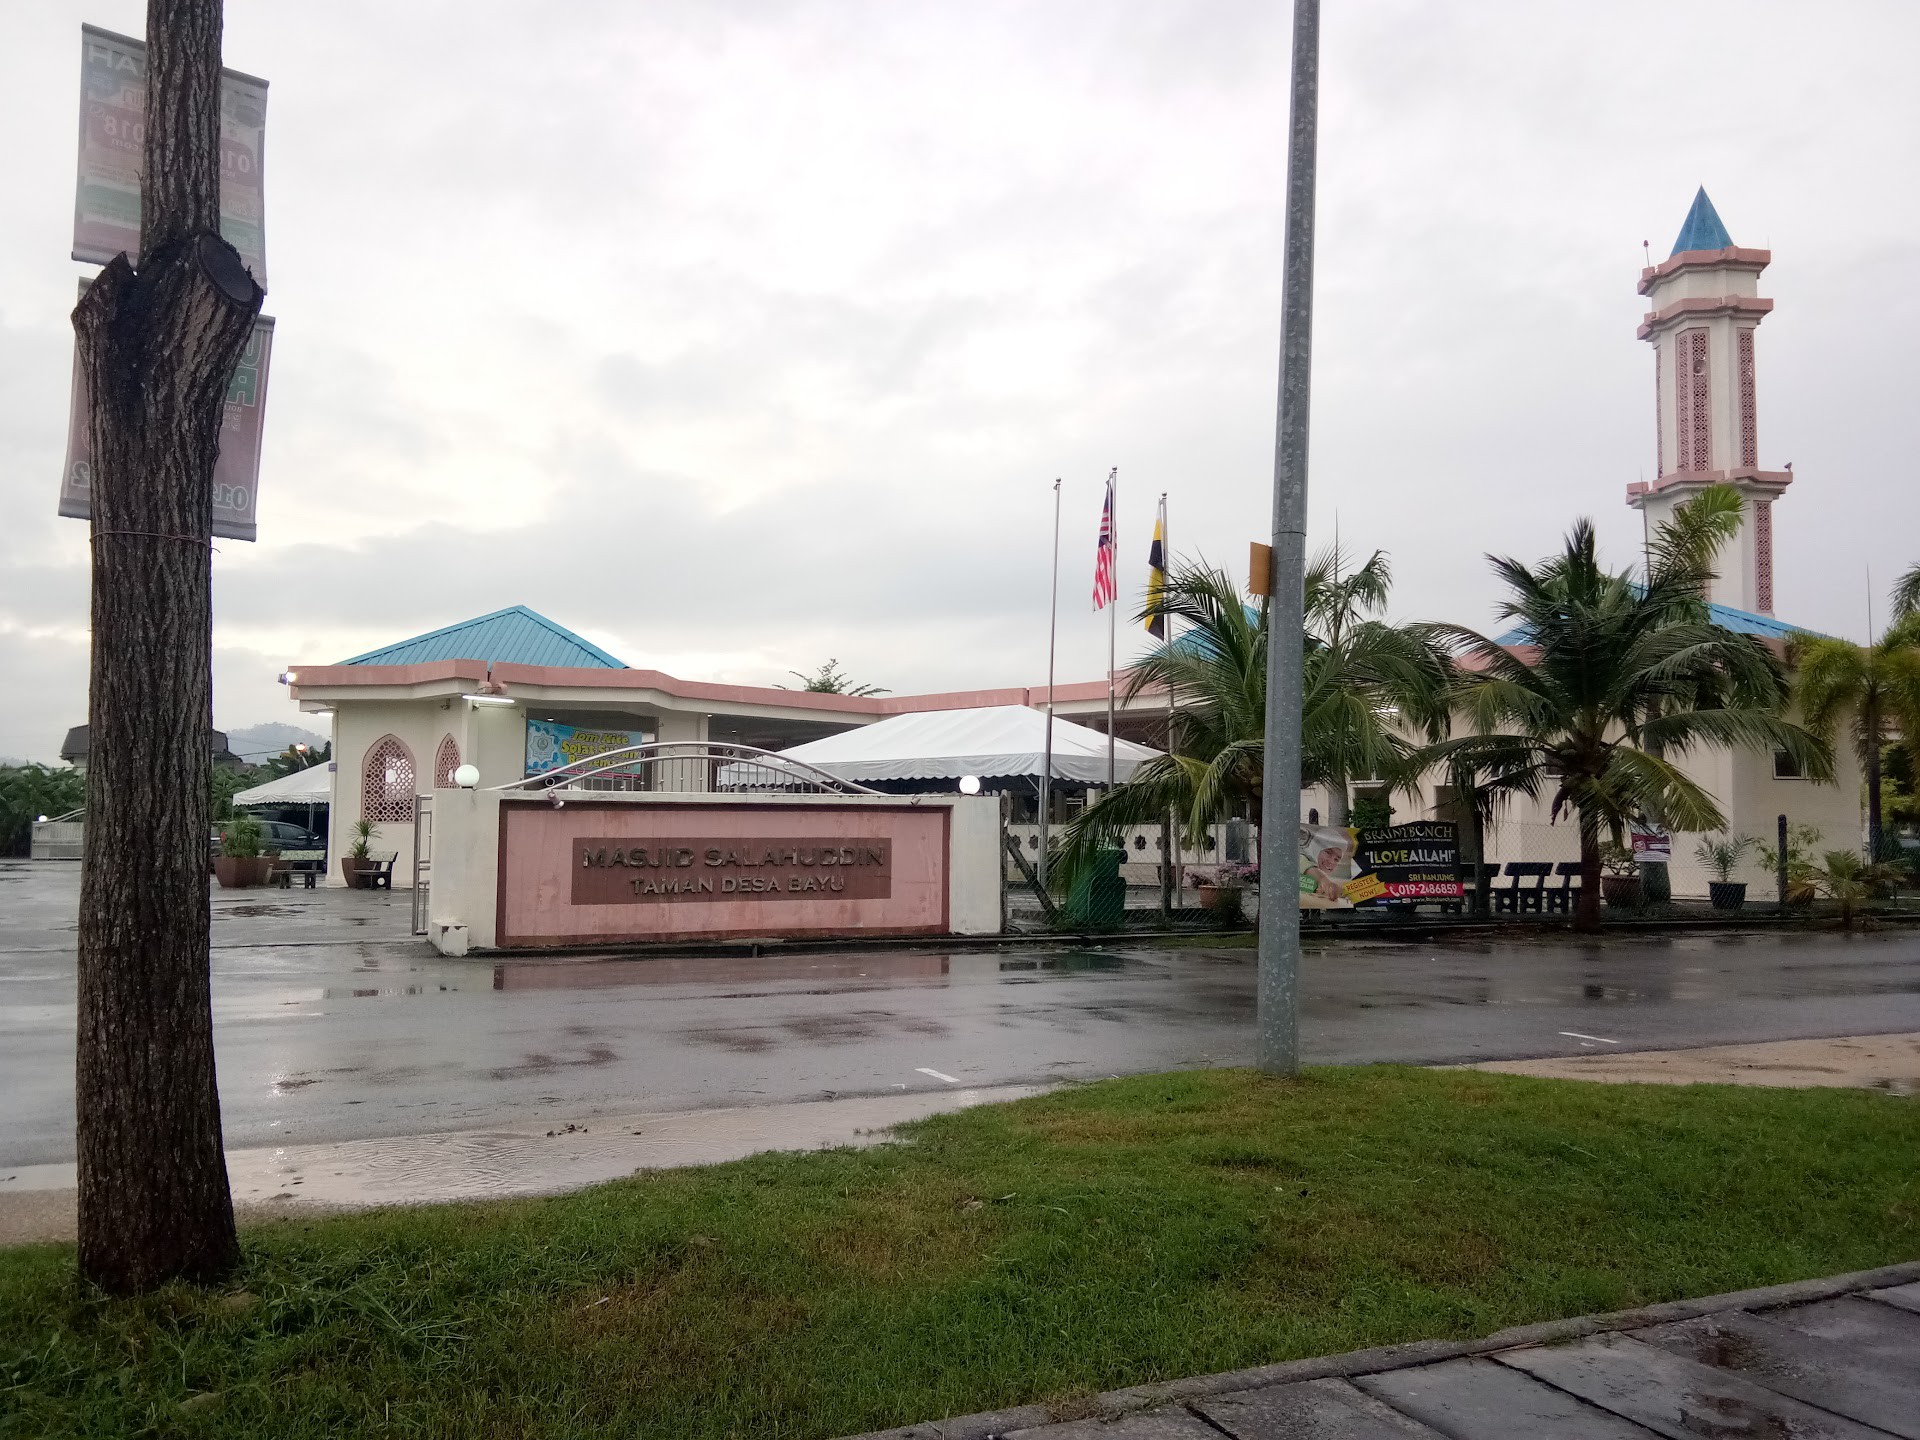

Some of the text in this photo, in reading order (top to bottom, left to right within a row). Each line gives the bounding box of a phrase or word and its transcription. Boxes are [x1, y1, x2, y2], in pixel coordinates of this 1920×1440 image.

[561, 741, 595, 755] Solat
[583, 845, 885, 868] MASJID SALAHUDDIN
[631, 875, 845, 895] TAMAN DESA BAYU
[1346, 877, 1375, 892] REGISTER
